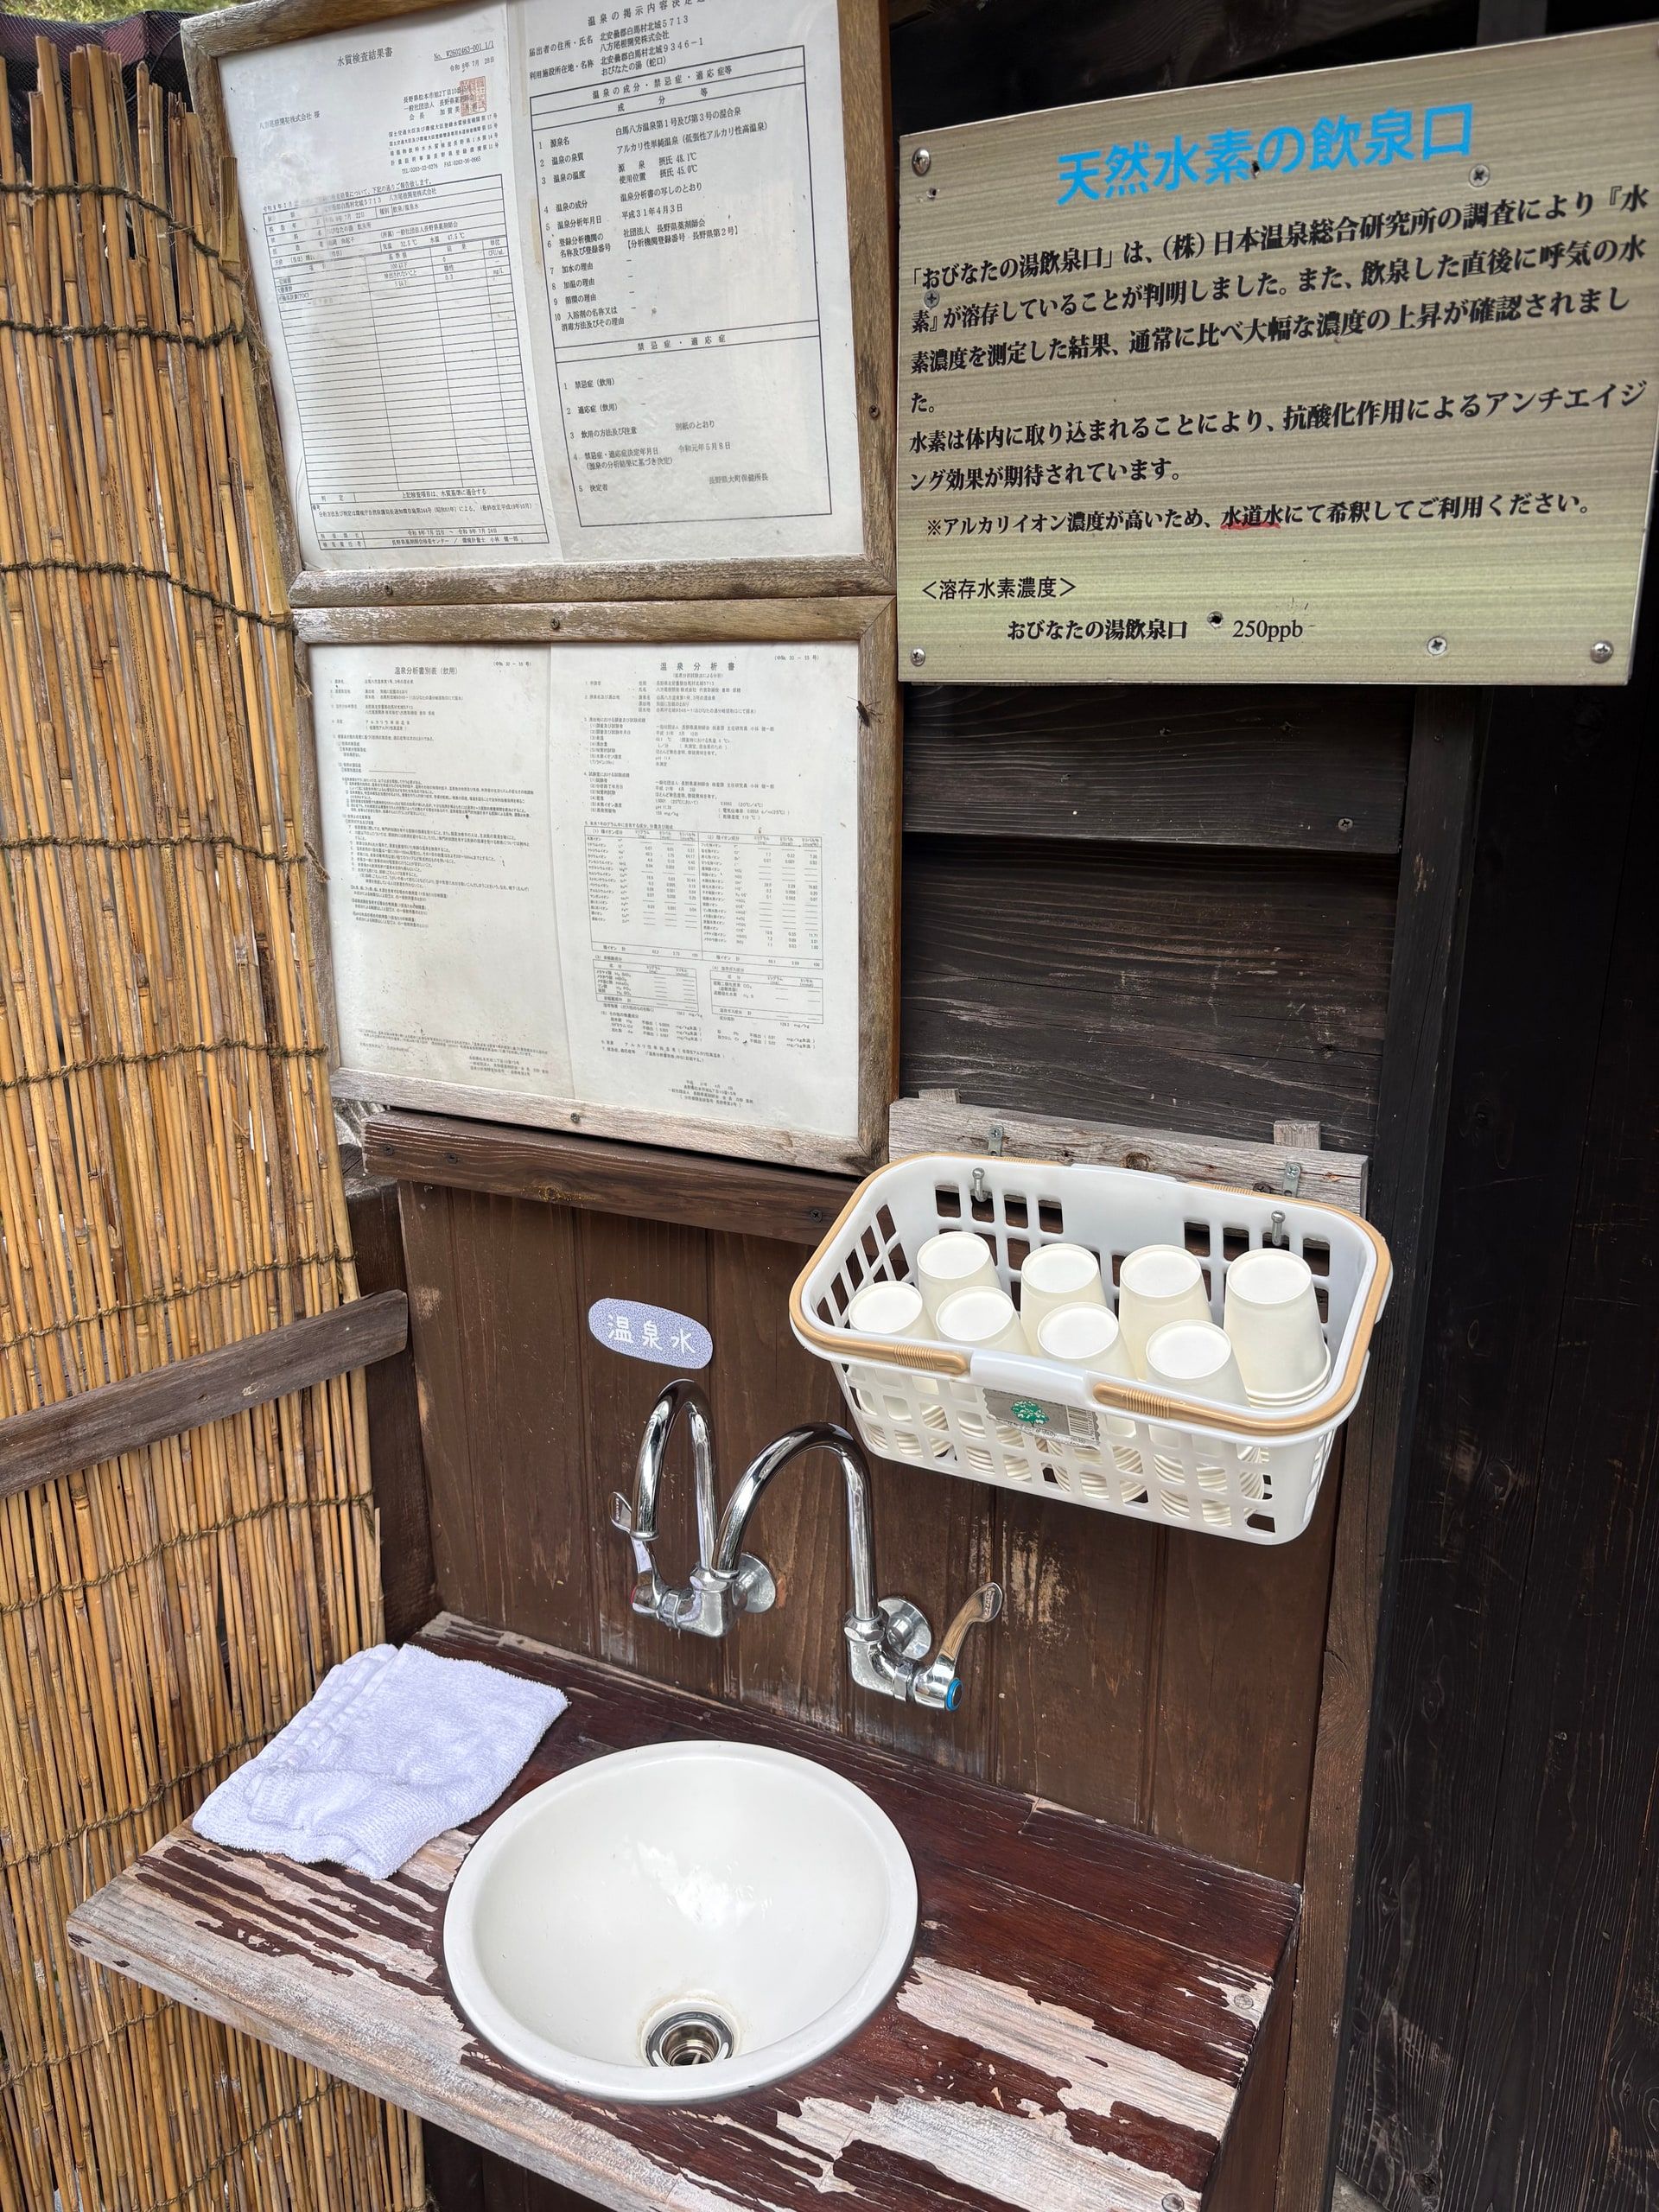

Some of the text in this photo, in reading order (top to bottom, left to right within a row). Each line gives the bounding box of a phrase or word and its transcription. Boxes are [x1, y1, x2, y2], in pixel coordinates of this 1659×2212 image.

[600, 30, 670, 52] 八方尾根開発株式会社
[337, 48, 393, 67] 水質検査結果書
[550, 137, 570, 148] 源泉名
[551, 152, 584, 165] 温泉の泉質
[1058, 104, 1471, 205] 天然水素の飲泉口
[553, 170, 586, 182] 温泉の温度
[619, 172, 647, 184] 使用位置
[555, 200, 588, 212] 温泉の成分
[620, 183, 702, 202] 温泉分析書の写しのとおり
[556, 215, 602, 230] 温泉分析年月日
[558, 233, 604, 246] 登録分析機関の
[623, 226, 651, 238] 社団法人
[657, 219, 706, 232] 長野県薬剤師会
[560, 243, 611, 257] 名称及び登録番号
[562, 262, 594, 273] 加水の理由
[563, 278, 595, 289] 加温の理由
[567, 306, 618, 320] 入浴剤の名称又は
[912, 287, 1629, 373] 素濃度を測定した結果、通常に比べ大幅な濃度の上昇が確認されまし
[912, 392, 934, 413] た。
[910, 380, 1647, 453] 水素は体内に取り込まれることにより、抗酸化作用によるアンチエイジ
[911, 458, 1179, 491] ング効果が期待されています。
[1007, 619, 1303, 643] おびなたの湯飲泉口 250ppb
[607, 1314, 696, 1354] 温泉水
